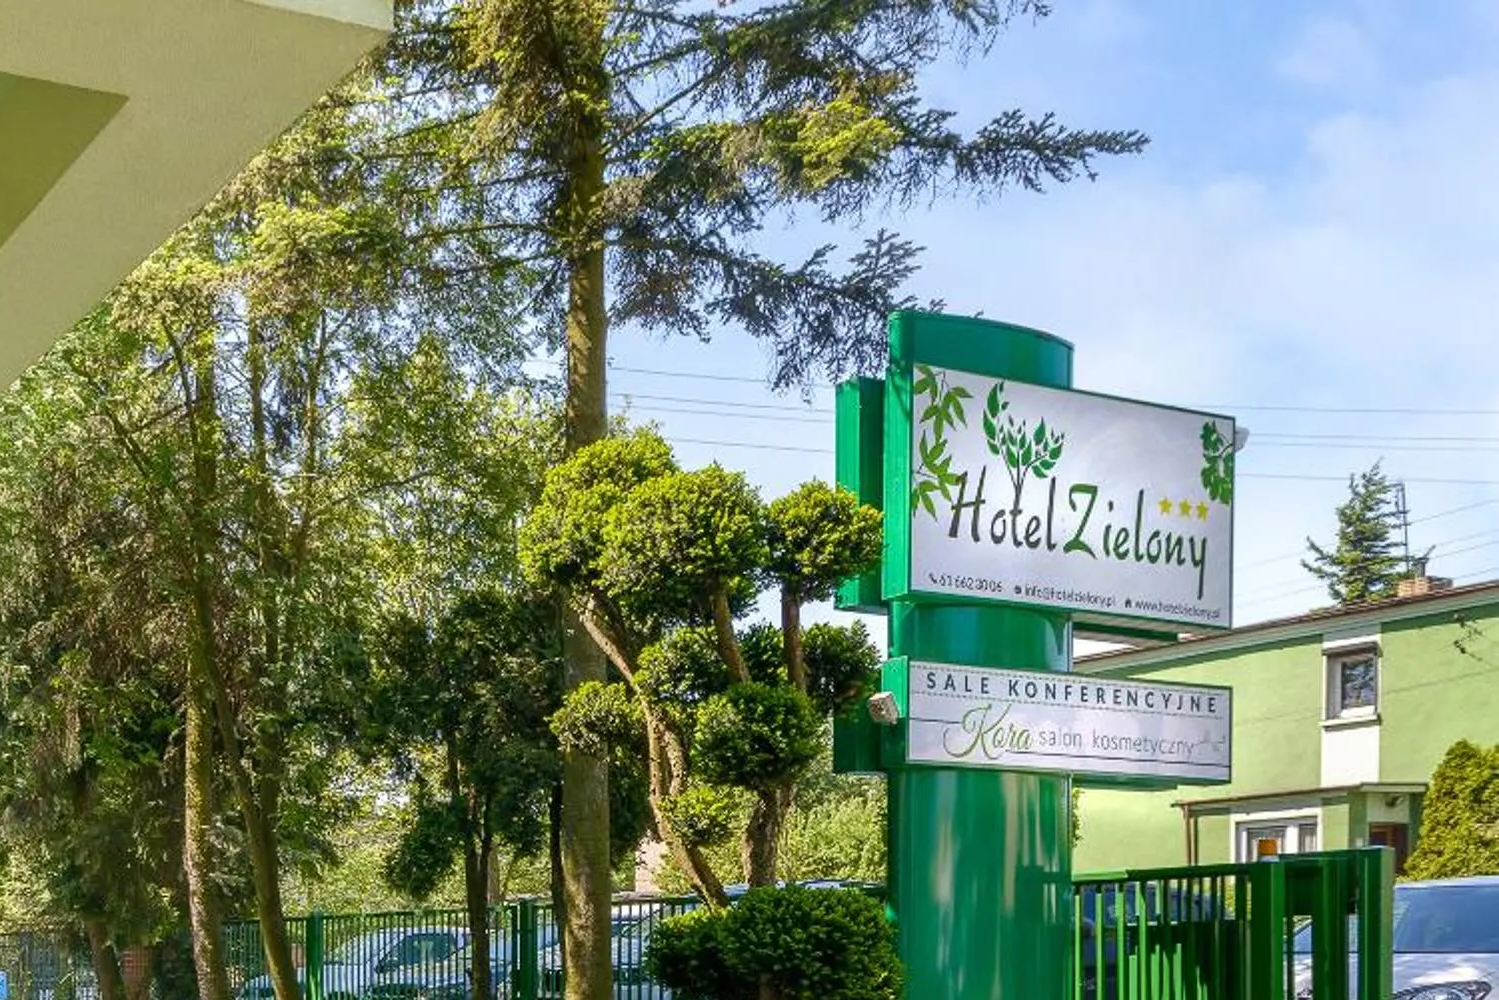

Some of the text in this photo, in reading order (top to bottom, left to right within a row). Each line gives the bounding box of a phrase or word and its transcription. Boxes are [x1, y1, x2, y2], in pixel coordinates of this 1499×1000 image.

[948, 465, 1208, 600] Hotel Zielony
[926, 672, 1217, 713] SALE KONFERENCYJNE
[1038, 729, 1083, 749] salon
[1092, 728, 1195, 758] kosmetyczny
